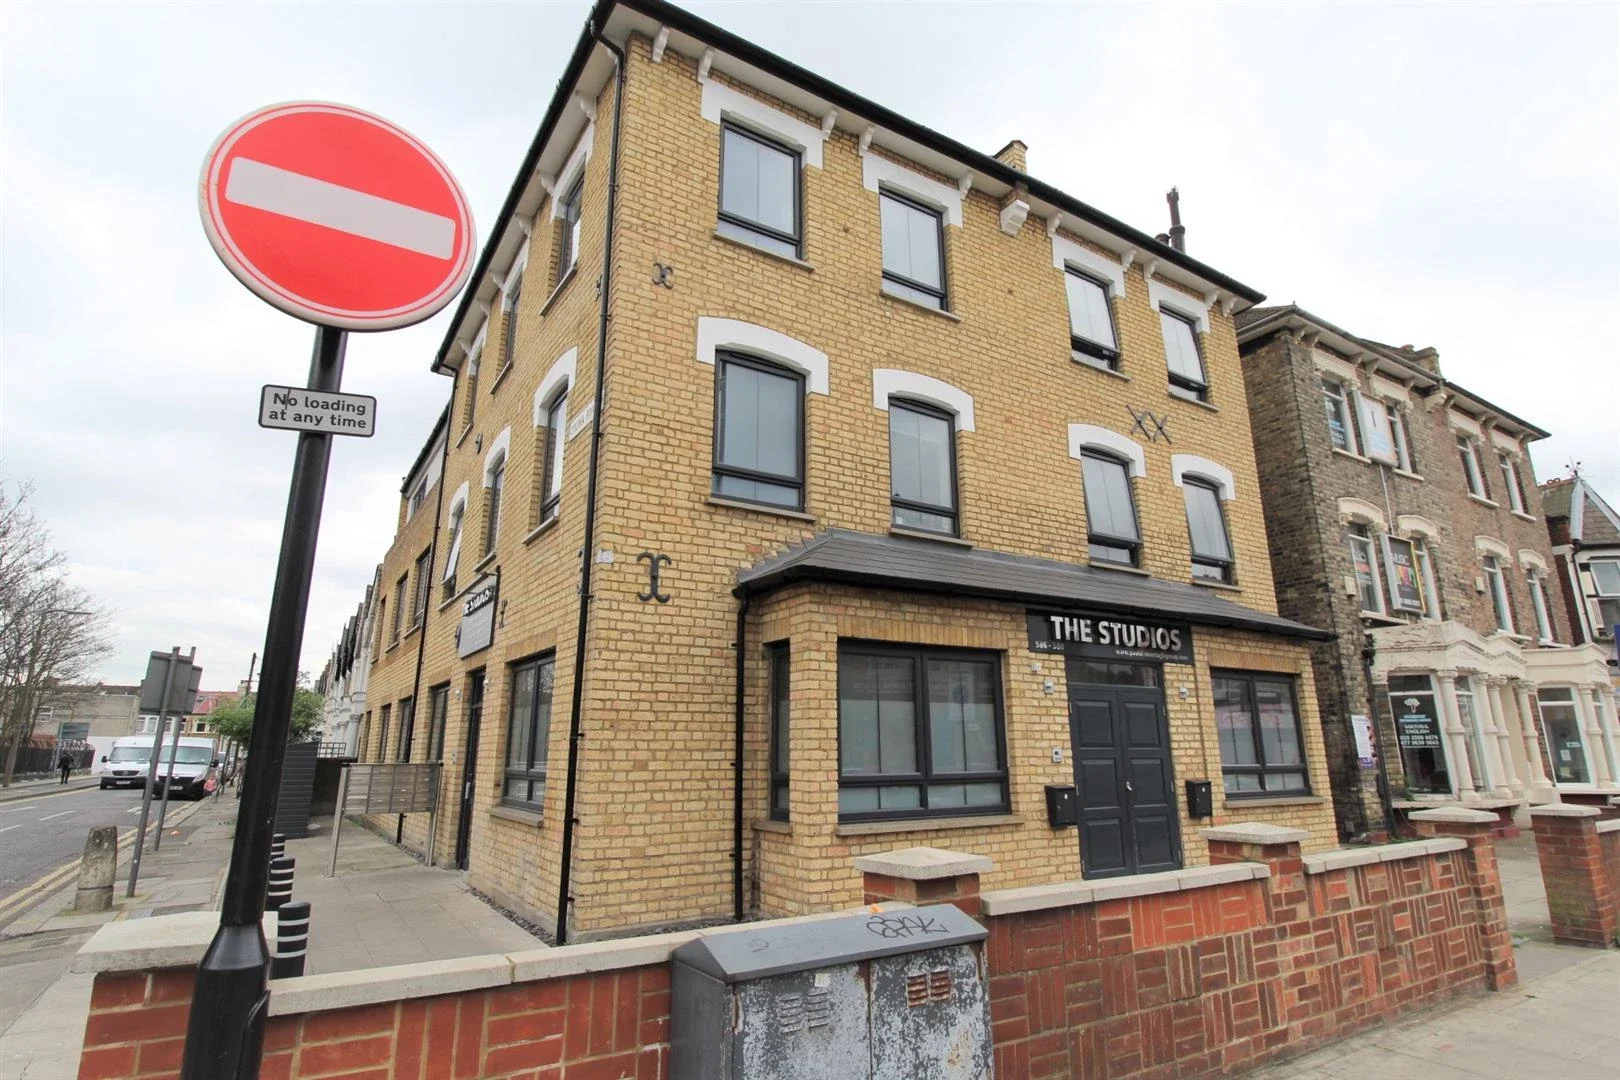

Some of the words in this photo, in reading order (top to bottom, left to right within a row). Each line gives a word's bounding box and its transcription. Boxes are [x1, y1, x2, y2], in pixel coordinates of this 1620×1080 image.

[273, 392, 298, 406] No
[304, 396, 366, 416] loading
[269, 409, 287, 421] at
[292, 412, 324, 426] any
[330, 413, 367, 429] time
[1050, 615, 1093, 643] THE
[1098, 620, 1182, 651] STUDIOS
